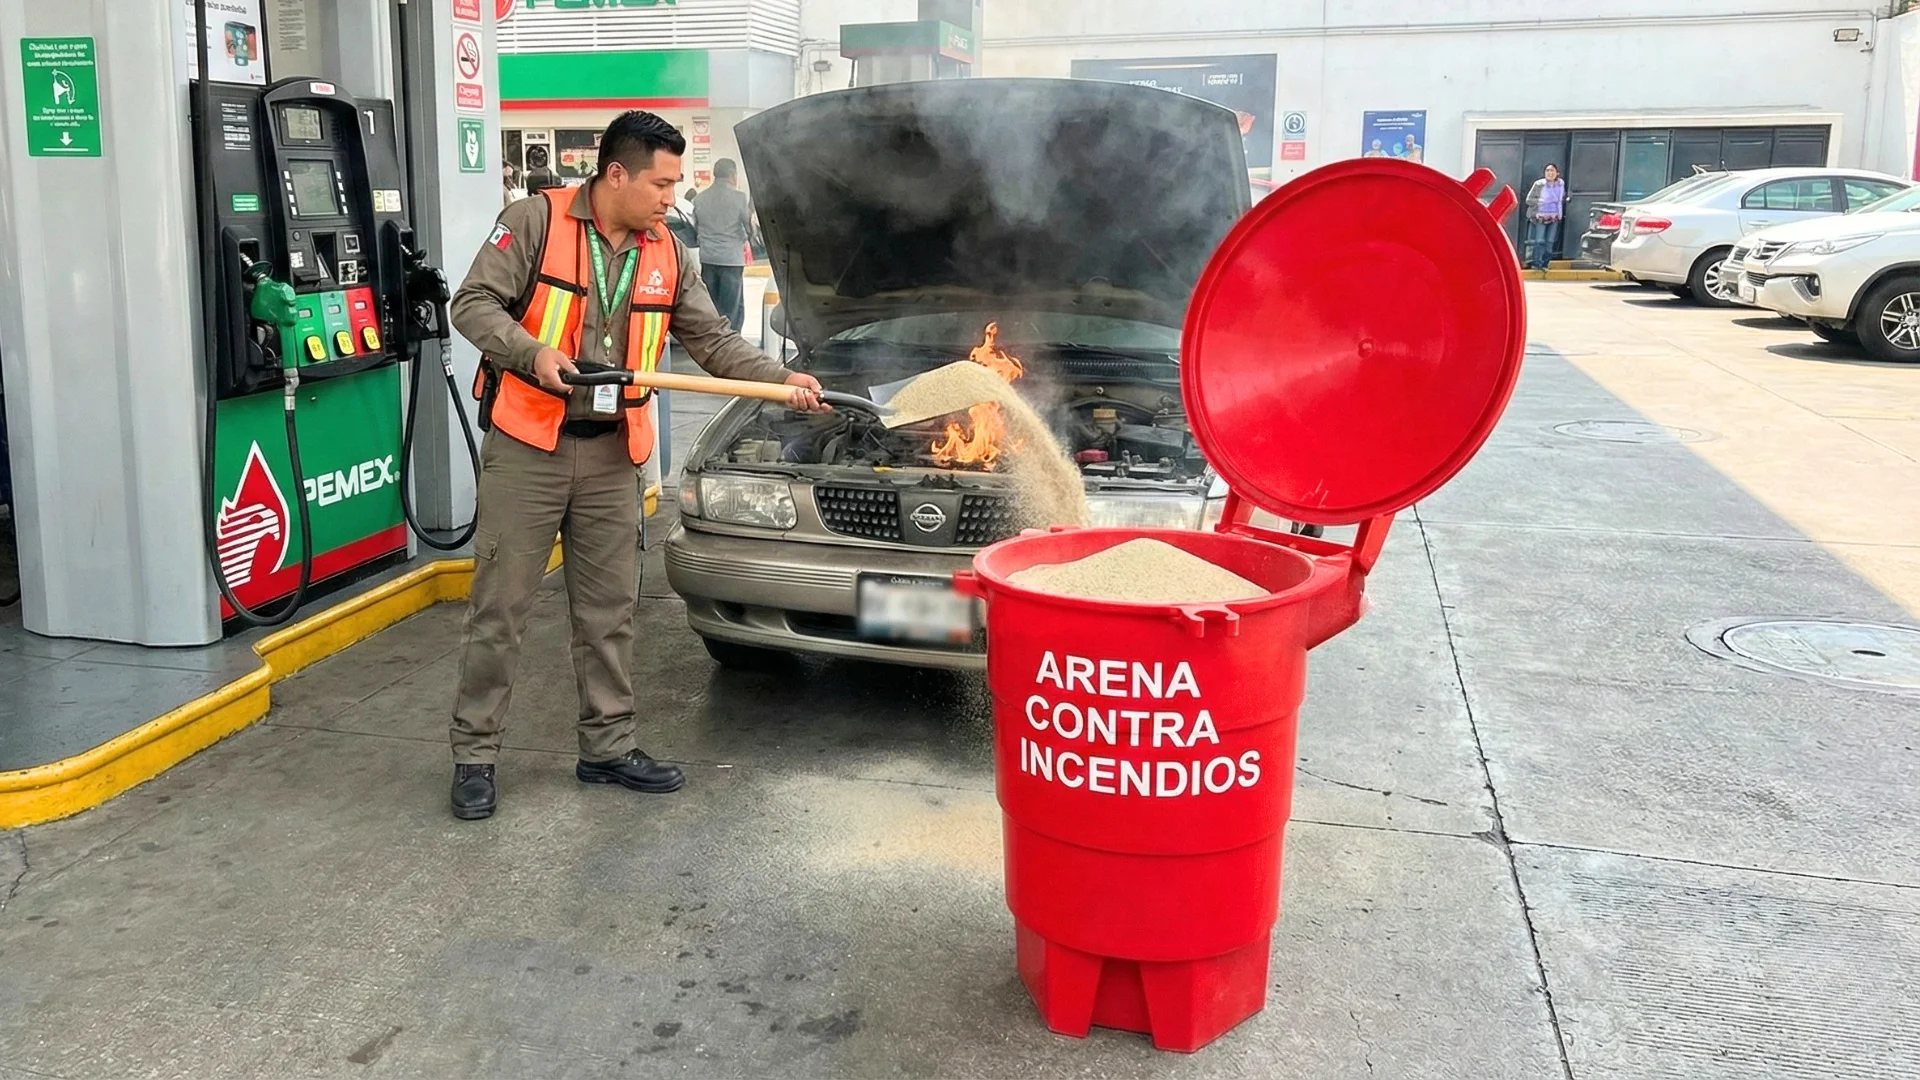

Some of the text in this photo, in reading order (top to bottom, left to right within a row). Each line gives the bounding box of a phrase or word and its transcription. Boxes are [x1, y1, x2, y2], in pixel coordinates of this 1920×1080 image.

[363, 110, 376, 134] 1
[303, 454, 394, 507] PEMEX
[1035, 650, 1202, 699] ARENA
[1025, 694, 1220, 748] CONTRA
[1020, 736, 1262, 798] INCENDIOS
